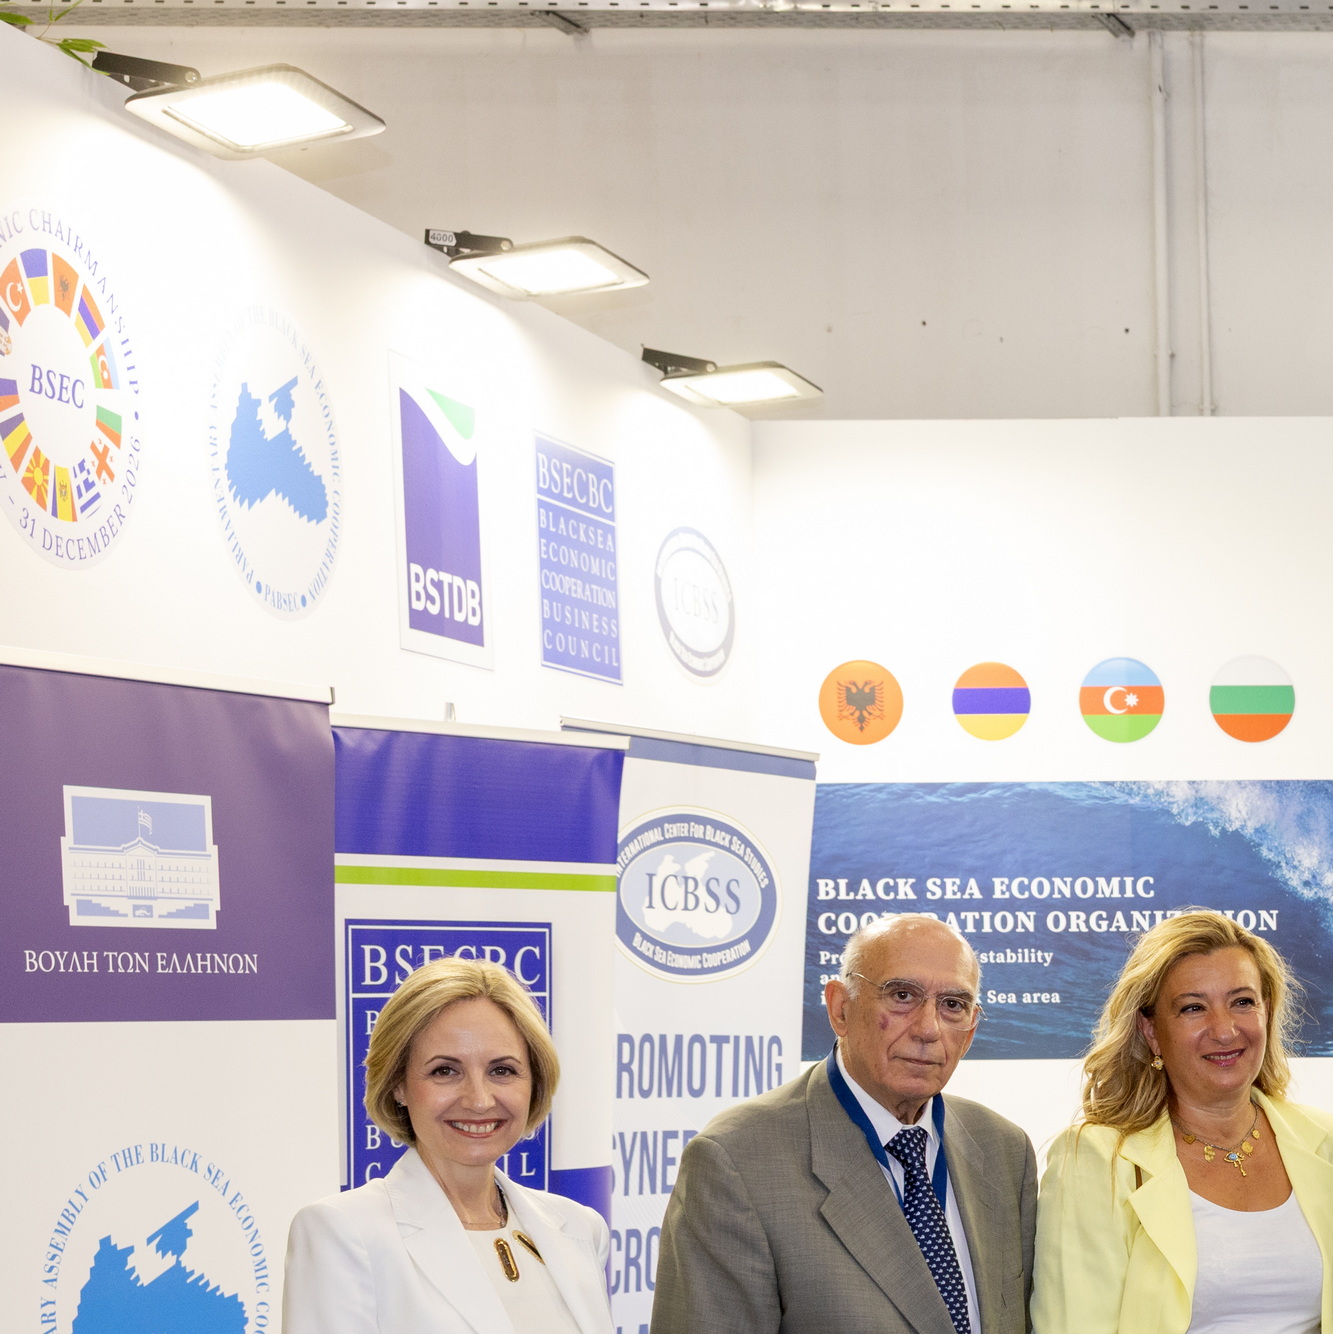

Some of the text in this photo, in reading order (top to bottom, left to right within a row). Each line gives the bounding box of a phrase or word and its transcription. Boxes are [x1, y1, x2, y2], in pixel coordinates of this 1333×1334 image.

[430, 232, 454, 243] 4000
[29, 208, 139, 394] CHAIRMANSHIP
[29, 363, 85, 409] BSEC
[19, 507, 36, 539] 31
[42, 503, 126, 561] DECEMBER
[121, 436, 141, 504] 2026
[537, 451, 613, 514] BSECBC
[539, 508, 614, 552] BLACKSEA
[540, 538, 615, 581] ECONOMIC
[264, 583, 300, 612] PABSEC
[409, 562, 481, 627] BSTDB
[541, 569, 616, 609] COOPERATION
[543, 599, 617, 638] BUSINESS
[544, 629, 618, 667] COUNCIL
[664, 823, 689, 839] CENTER
[690, 822, 705, 839] FOR
[705, 825, 733, 848] BLACK
[731, 836, 746, 855] SEA
[743, 848, 769, 889] STUDIES
[645, 873, 741, 915] ICBSS
[817, 877, 1155, 900] BLACK SEA ECONOMIC
[24, 949, 259, 974] ΒΟΥΛΗ ΤΩΝ ΕΛΛΗΝΩΝ
[632, 932, 751, 969] BLACK SEA ECONOMIC COOPERATION
[980, 948, 1054, 967] stability
[987, 990, 1017, 1004] Sea
[1022, 993, 1061, 1003] area
[616, 1033, 782, 1099] ROMOTING
[41, 1184, 90, 1290] ASSEMBLY
[88, 1161, 109, 1190] OF
[110, 1144, 146, 1174] THE
[149, 1142, 204, 1175] BLACK
[203, 1162, 232, 1197] SEA
[228, 1191, 271, 1294] ECONOMIC
